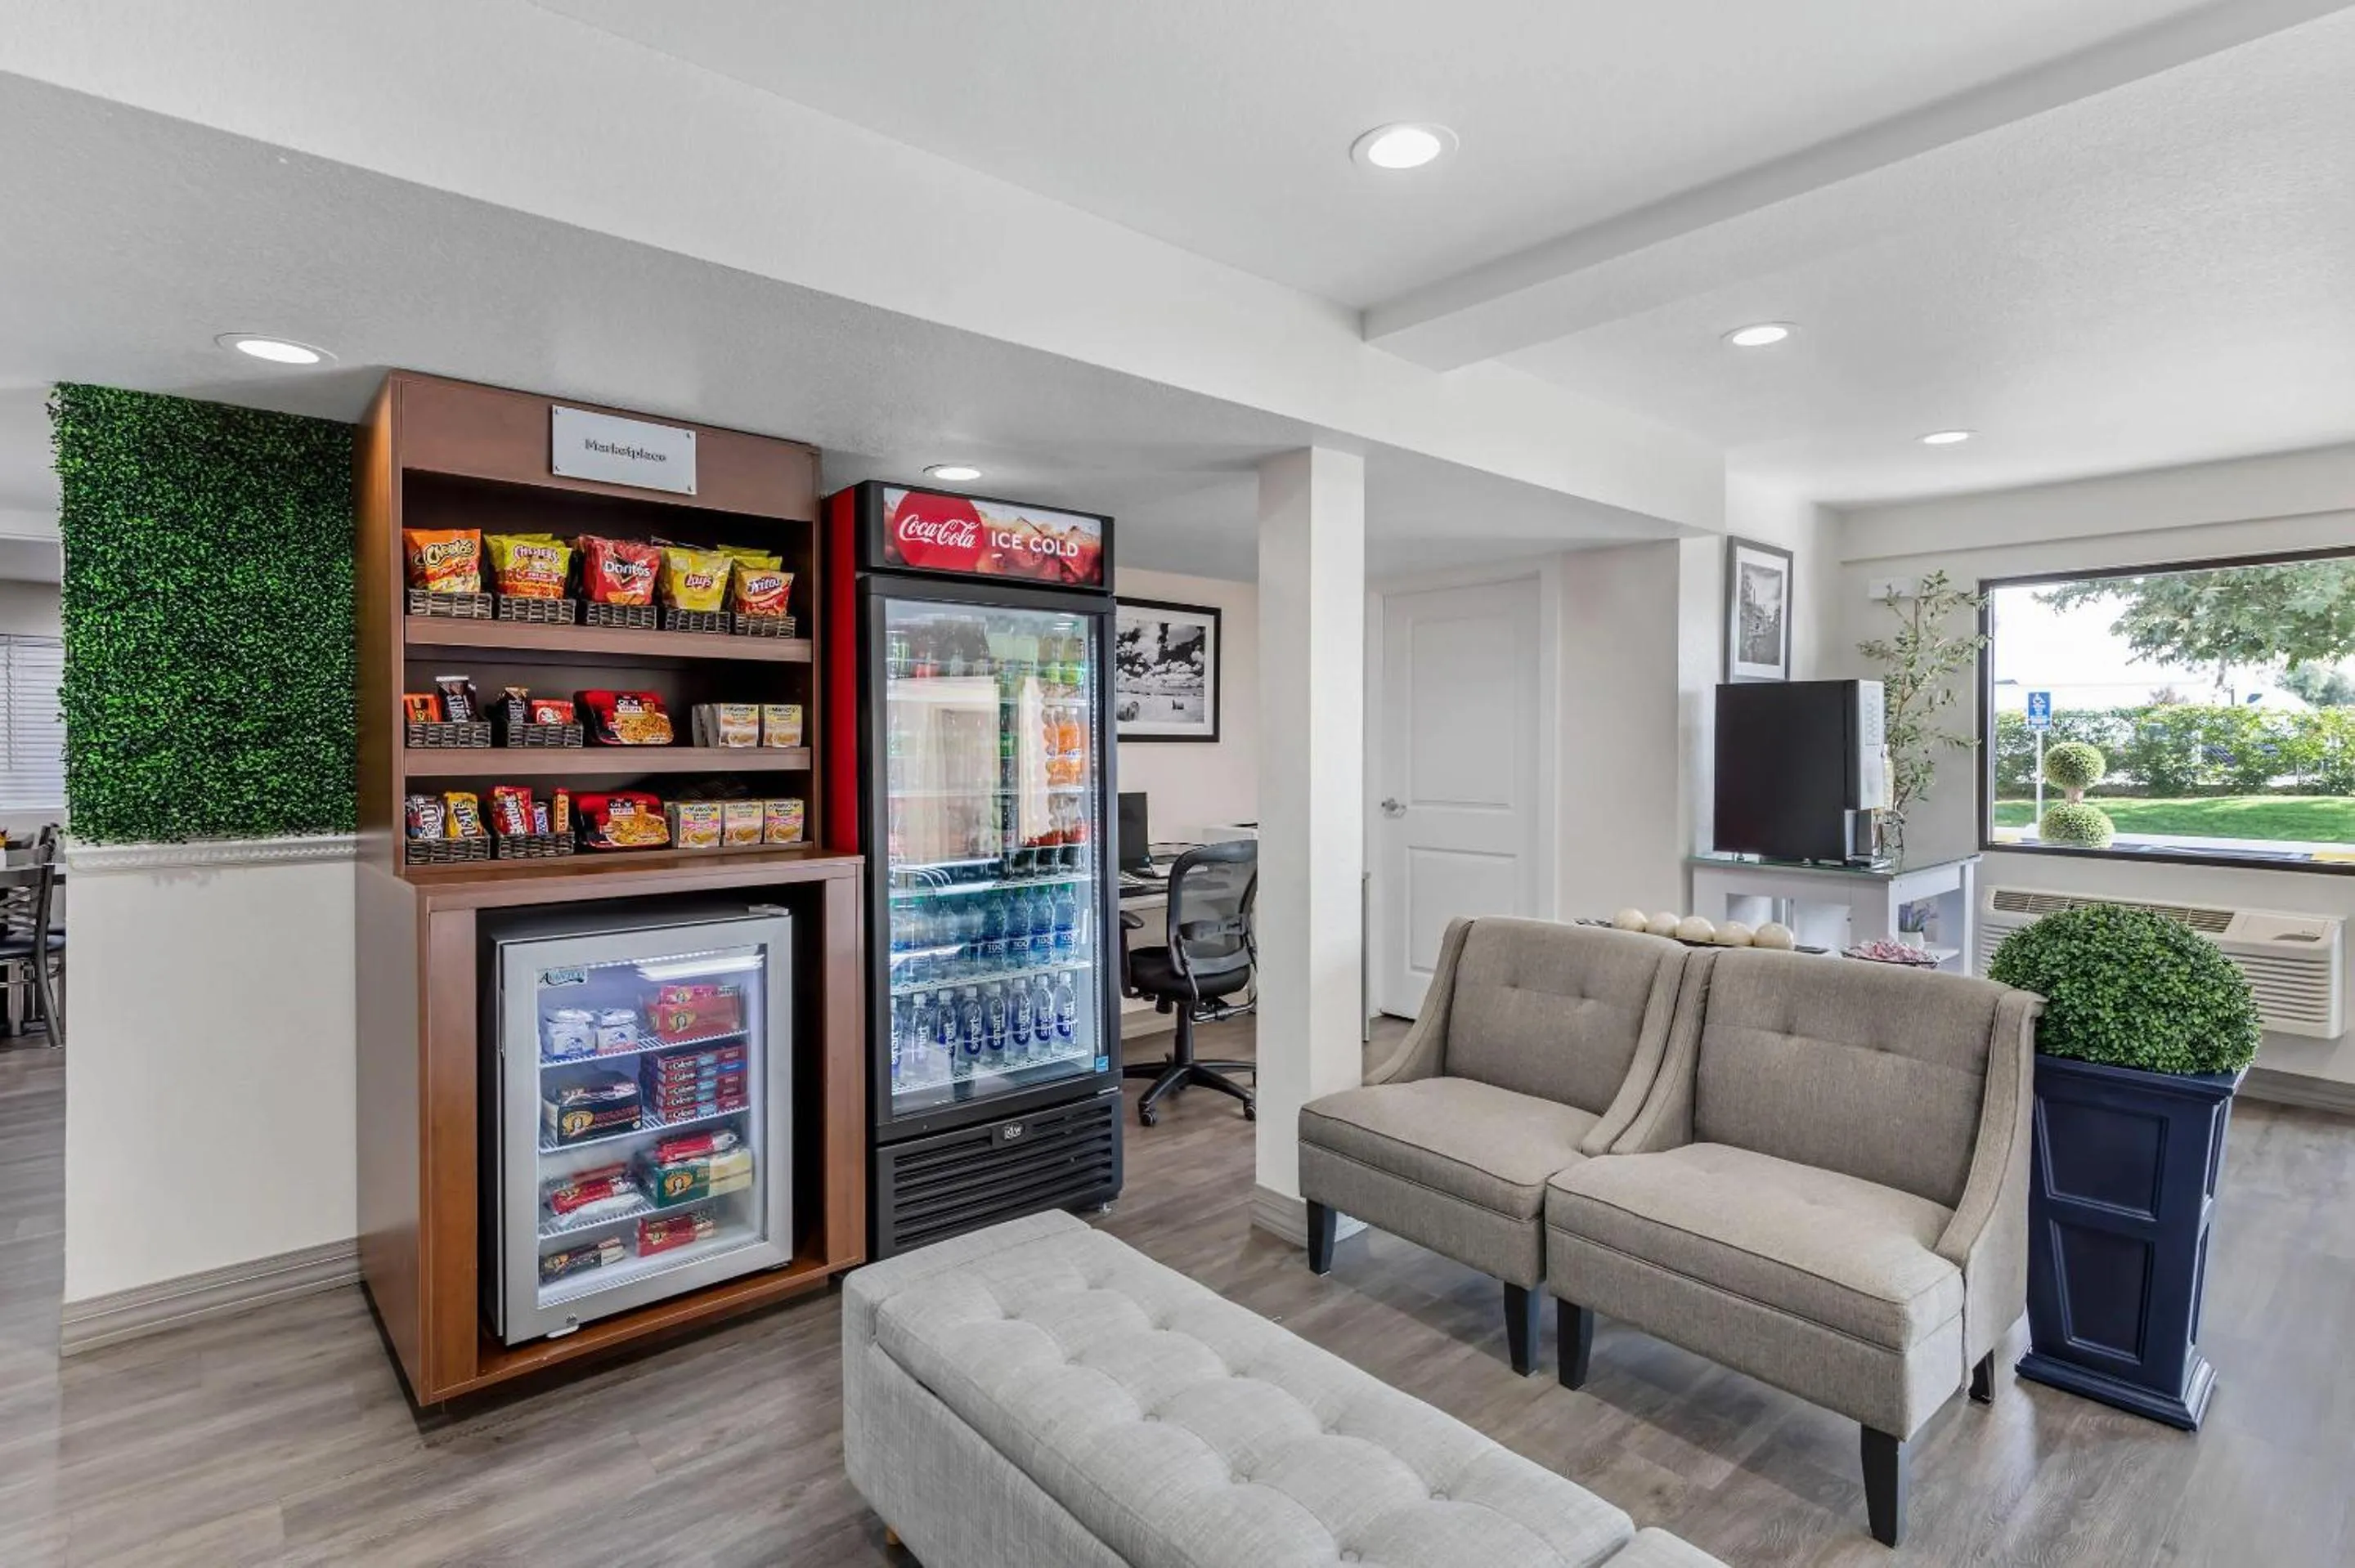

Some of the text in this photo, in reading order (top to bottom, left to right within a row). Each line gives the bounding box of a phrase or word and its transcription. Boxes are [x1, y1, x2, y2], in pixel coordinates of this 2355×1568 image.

[585, 438, 666, 463] Marketplace
[899, 514, 1079, 558] Coca-Cola ICE COLD
[424, 539, 476, 567] Cheetos
[604, 559, 651, 577] Doritos
